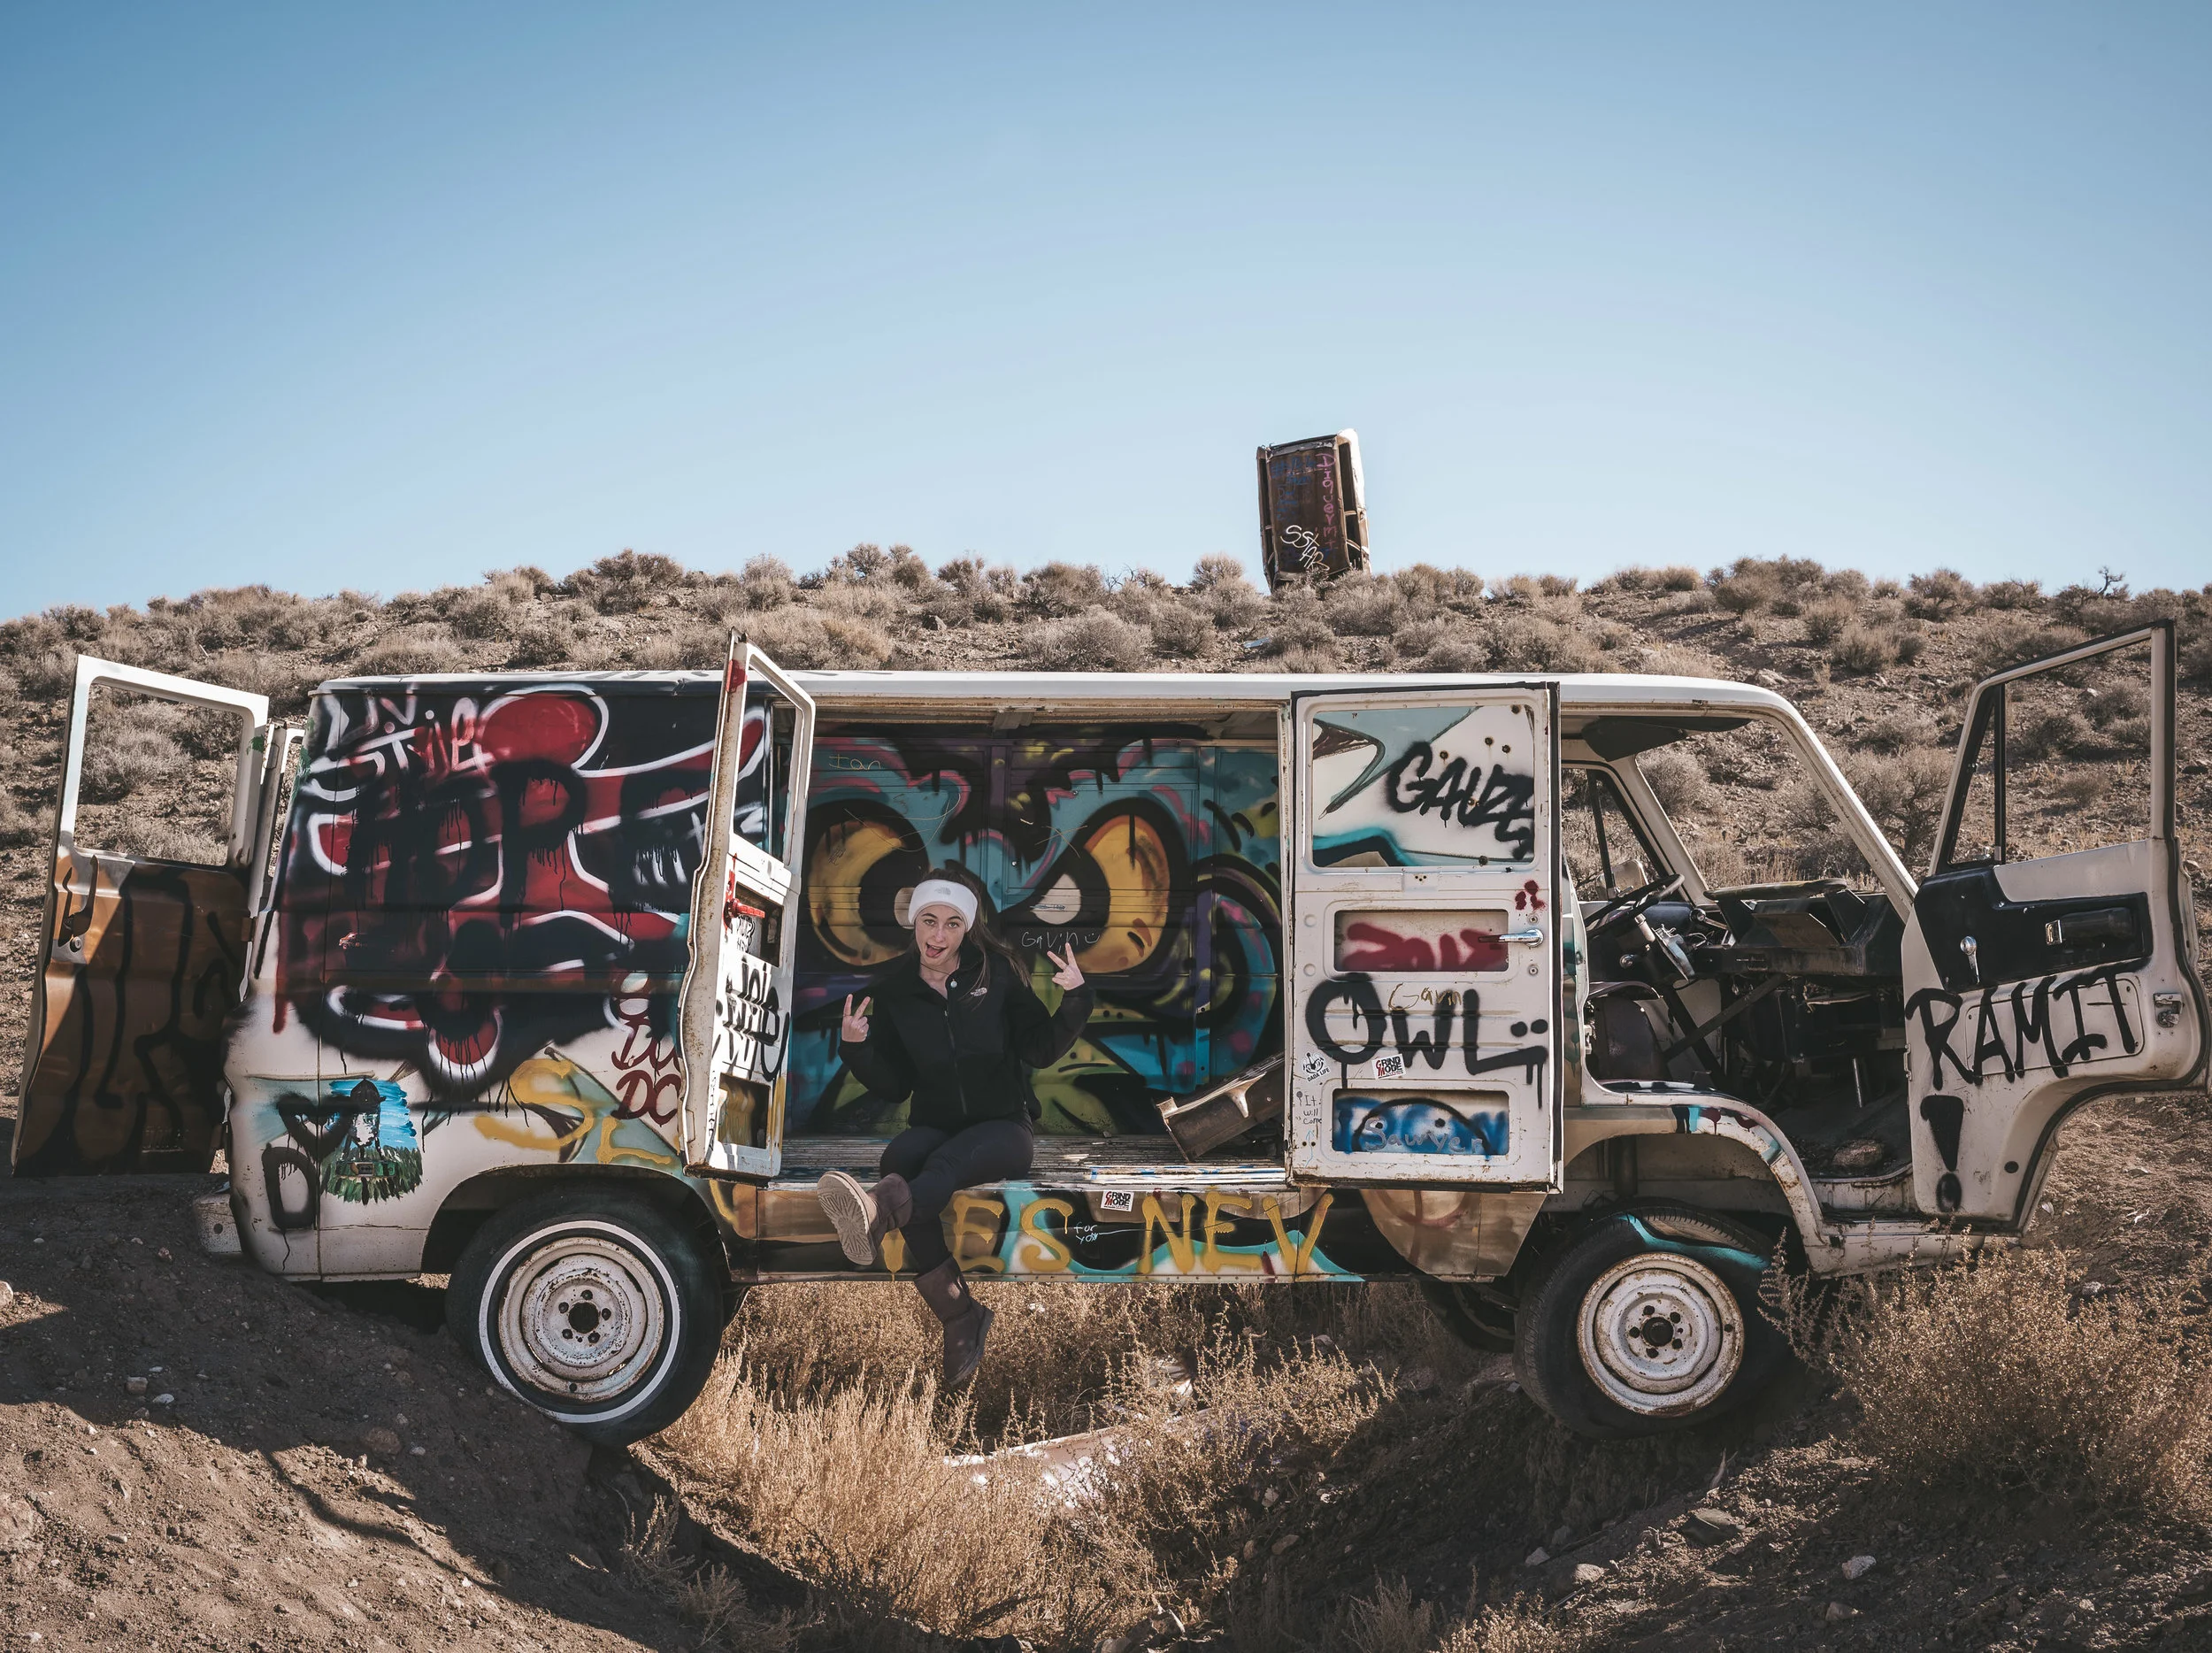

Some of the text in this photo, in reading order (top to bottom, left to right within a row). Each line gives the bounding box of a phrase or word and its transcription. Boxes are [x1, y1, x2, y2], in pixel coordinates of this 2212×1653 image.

[829, 754, 881, 770] Ian
[1388, 982, 1462, 1011] Gavin
[1305, 972, 1548, 1076] OWL
[1376, 1056, 1401, 1069] GRIND
[1378, 1064, 1403, 1076] MODE
[1305, 1095, 1316, 1106] It
[1364, 1118, 1483, 1153] Sawyer
[1105, 1191, 1131, 1201] GRIND
[1105, 1197, 1130, 1207] MODE
